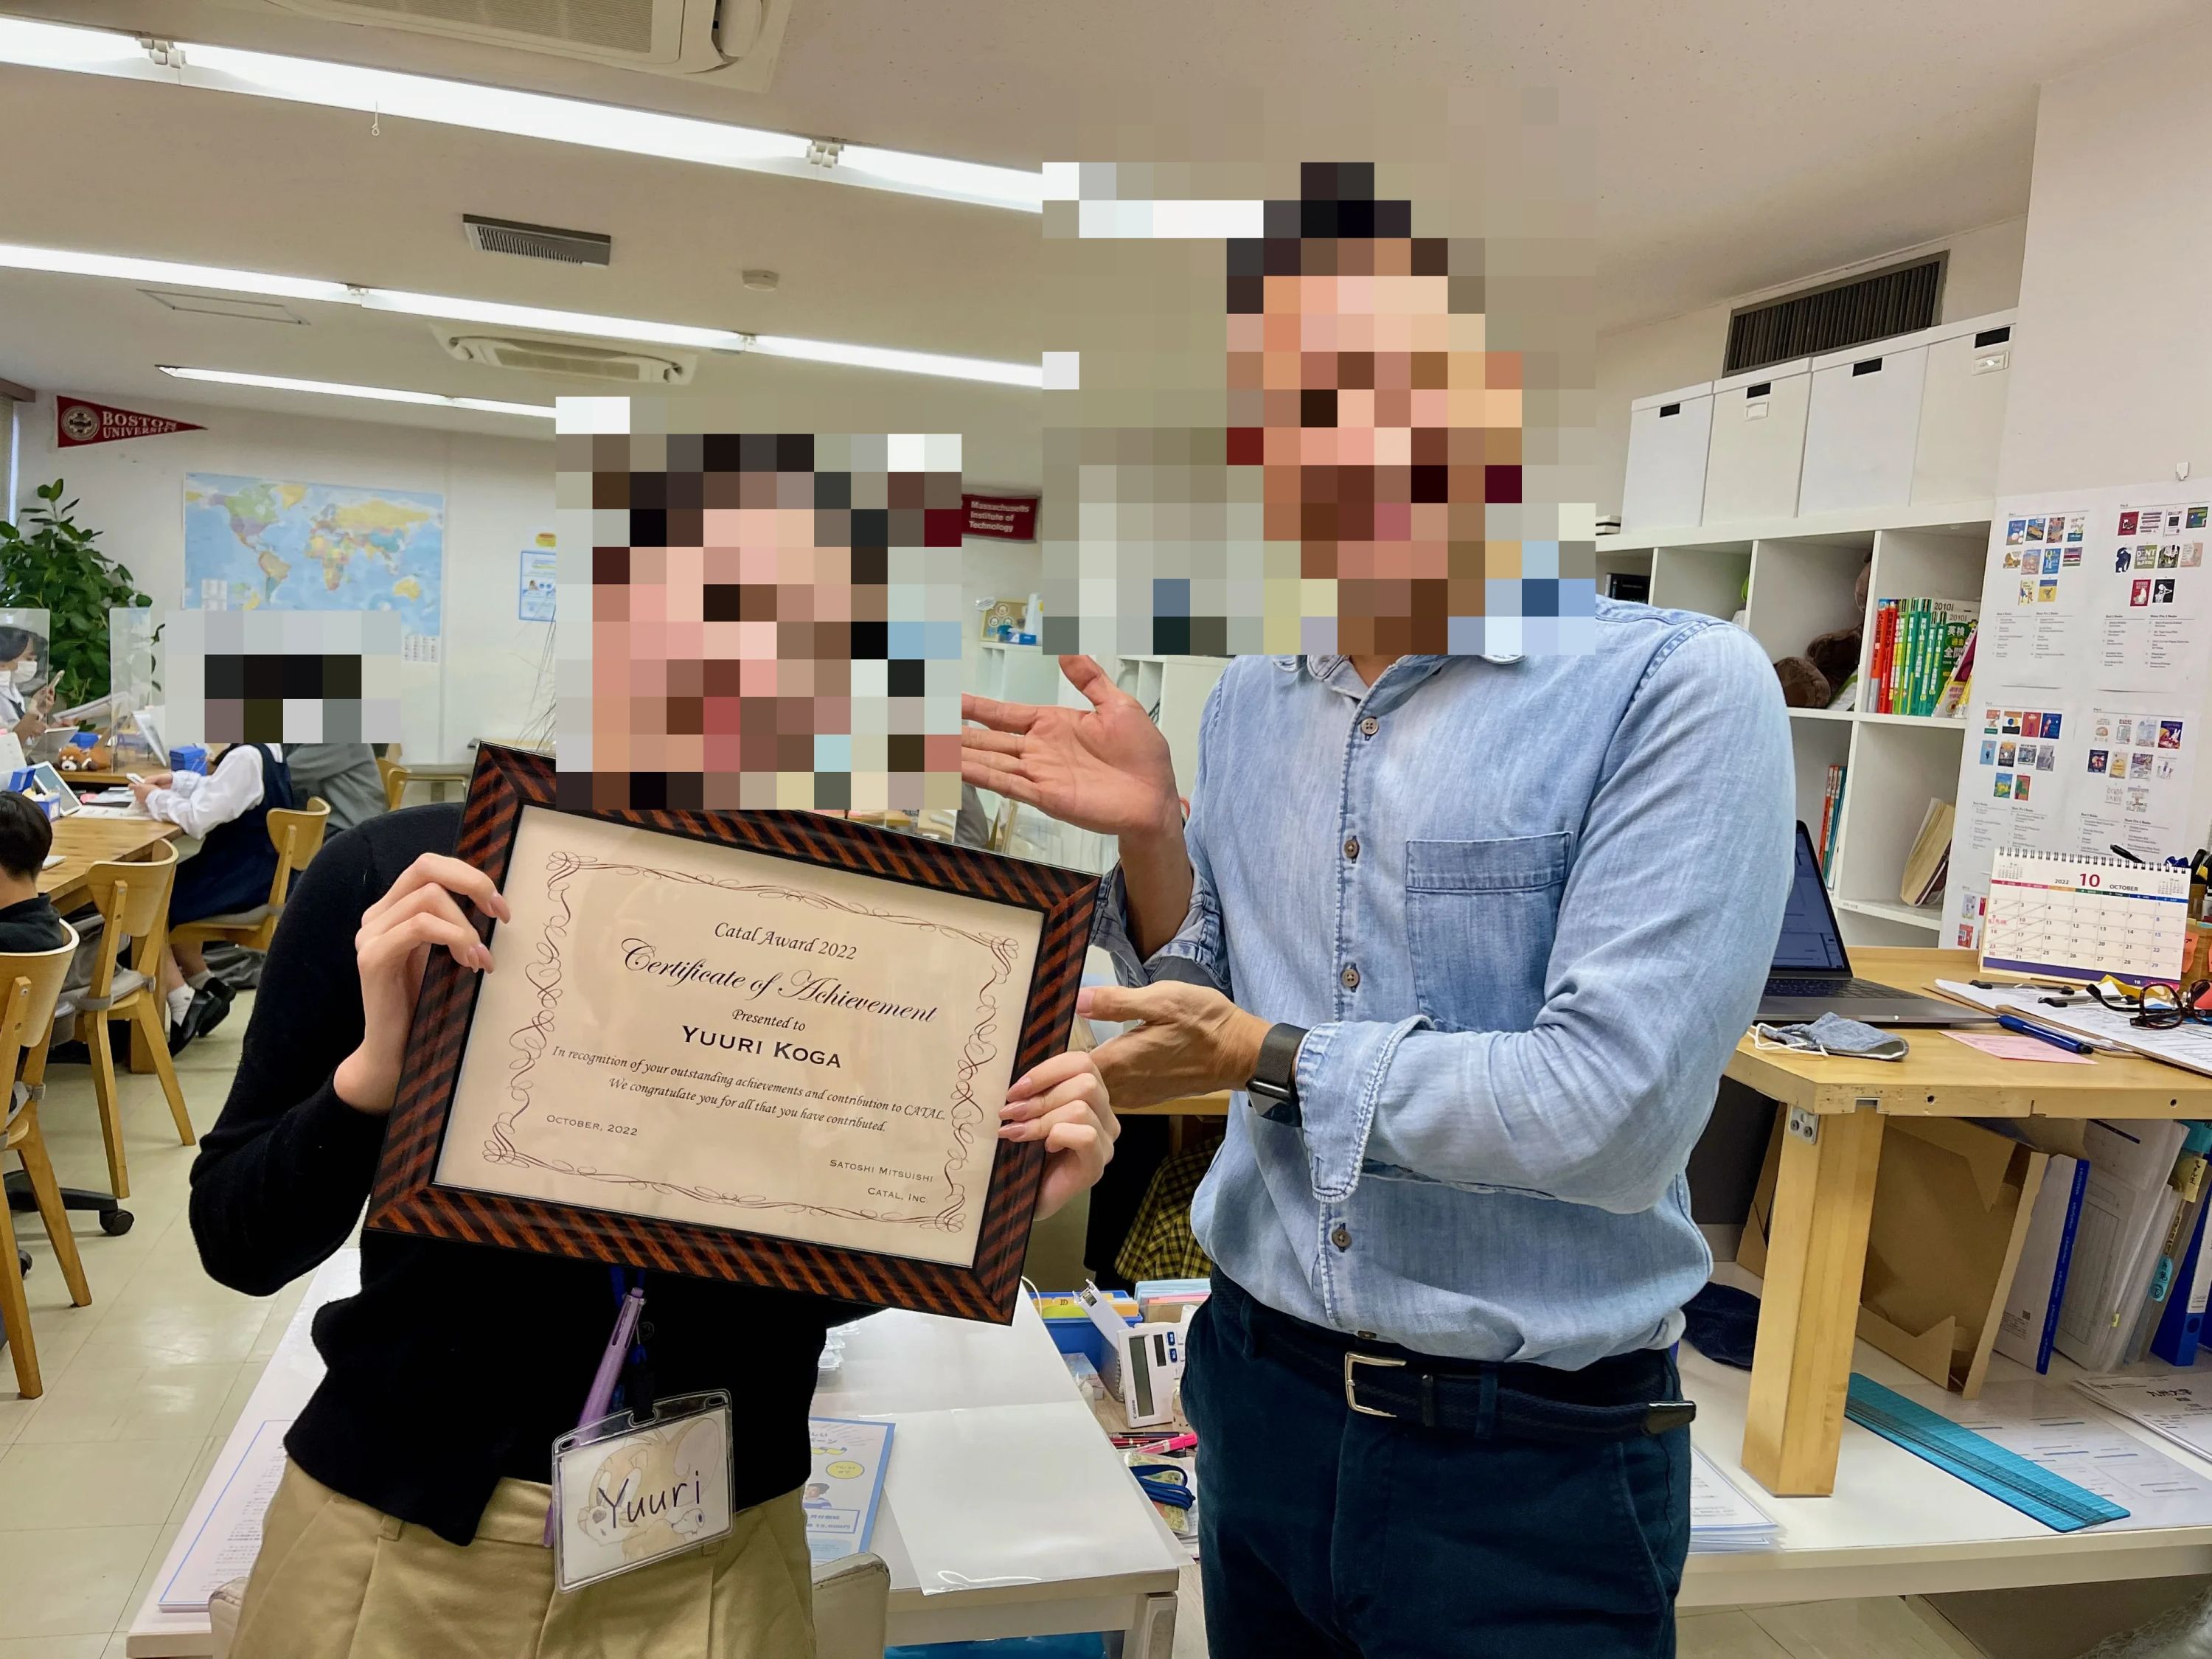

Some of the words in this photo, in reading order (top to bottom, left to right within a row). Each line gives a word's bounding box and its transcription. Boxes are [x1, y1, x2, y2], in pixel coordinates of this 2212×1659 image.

[102, 410, 177, 428] BOSTON
[103, 425, 176, 439] UNIVERSITY
[970, 511, 1004, 521] Institute
[971, 501, 1029, 512] Massachusetts
[969, 520, 1014, 532] Technology
[2079, 873, 2101, 888] 10
[2109, 884, 2138, 892] OCTOBER
[714, 922, 762, 942] Catal
[757, 931, 819, 952] Award
[818, 941, 858, 960] 2022
[622, 937, 746, 988] Certificate
[744, 971, 784, 1001] of
[777, 969, 939, 1023] Achievement
[731, 1009, 794, 1029] Presented
[793, 1020, 806, 1032] to
[681, 1025, 763, 1054] YUURI
[773, 1041, 841, 1068] KOGA
[552, 1046, 566, 1057] In
[568, 1050, 627, 1068] recognition
[630, 1059, 646, 1072] of
[641, 1062, 670, 1074] your
[670, 1068, 734, 1088] outstanding
[735, 1077, 803, 1097] achievements
[804, 1089, 829, 1100] and
[827, 1093, 889, 1111] contribution
[891, 1103, 902, 1113] to
[904, 1104, 945, 1120] CATAL.
[609, 1077, 627, 1090] We
[630, 1083, 697, 1102] congratulate
[696, 1094, 718, 1105] you
[716, 1096, 737, 1108] for
[738, 1099, 754, 1110] all
[754, 1101, 777, 1114] that
[776, 1106, 798, 1118] you
[800, 1107, 824, 1121] have
[827, 1115, 886, 1132] contributed.
[546, 1114, 603, 1132] OCTOBER,
[607, 1124, 639, 1136] 2022
[830, 1158, 874, 1173] SATOSHI
[878, 1166, 934, 1183] MITSUISHI
[867, 1187, 903, 1201] CATAL,
[598, 1470, 700, 1528] Yuuri
